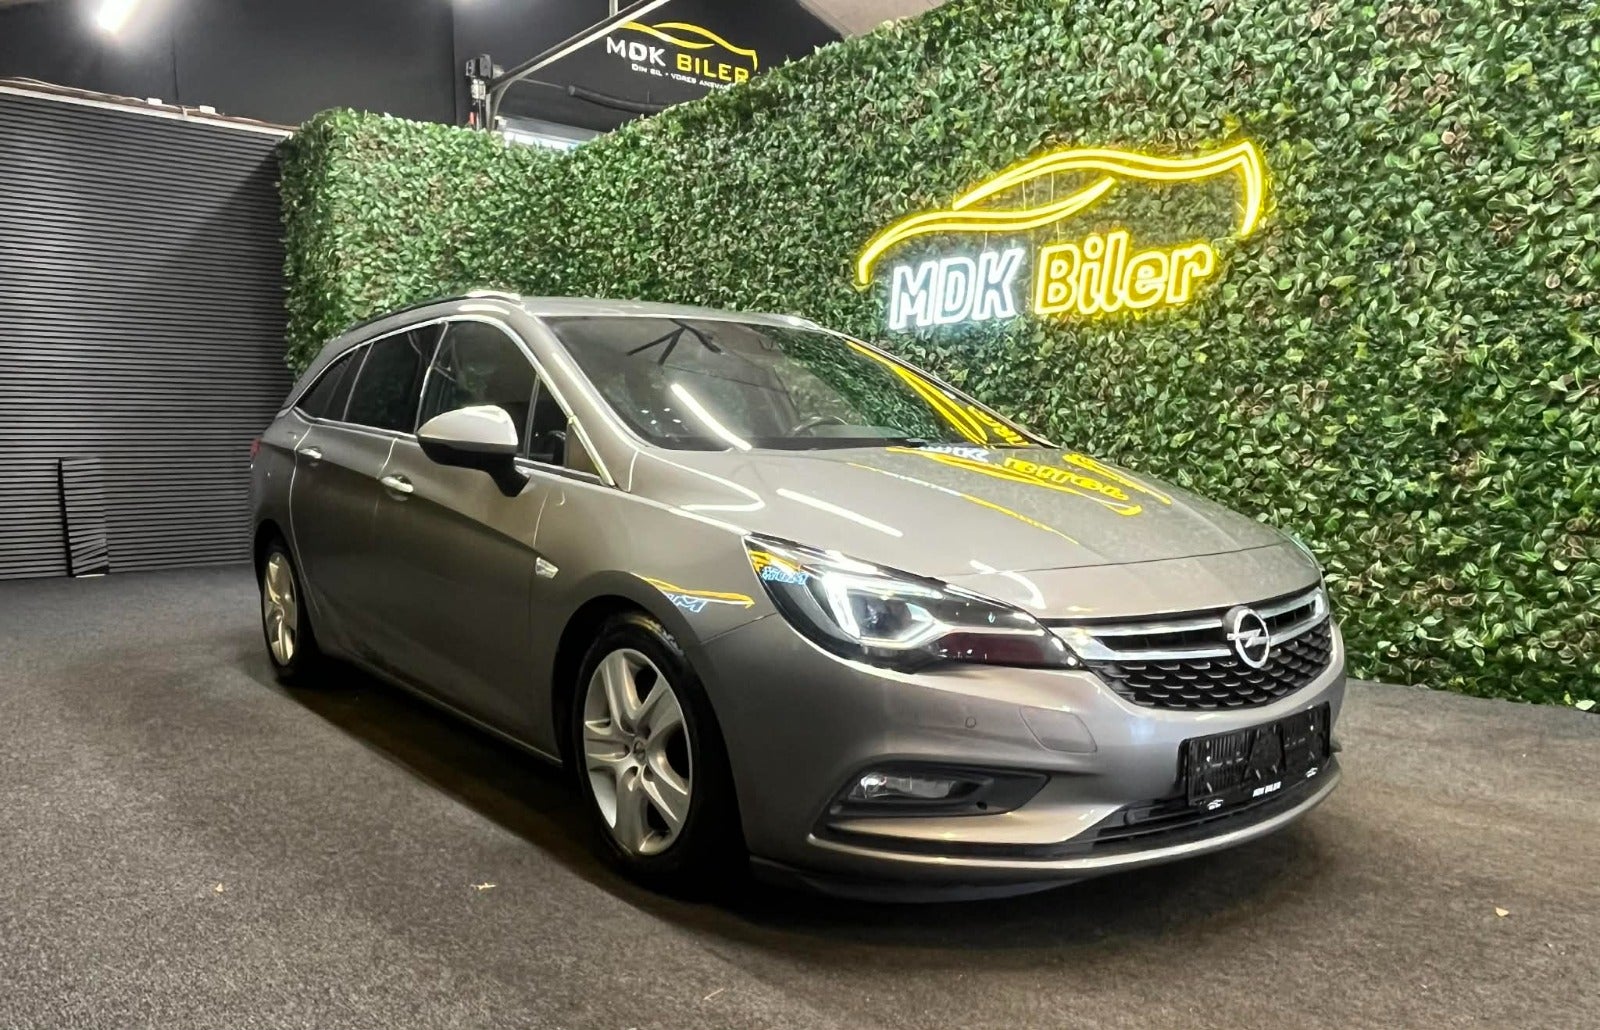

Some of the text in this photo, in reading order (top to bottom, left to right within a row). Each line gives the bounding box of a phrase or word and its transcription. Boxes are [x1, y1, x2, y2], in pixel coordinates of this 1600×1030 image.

[606, 36, 749, 83] MDK BILER
[888, 230, 1215, 331] MDK Biler
